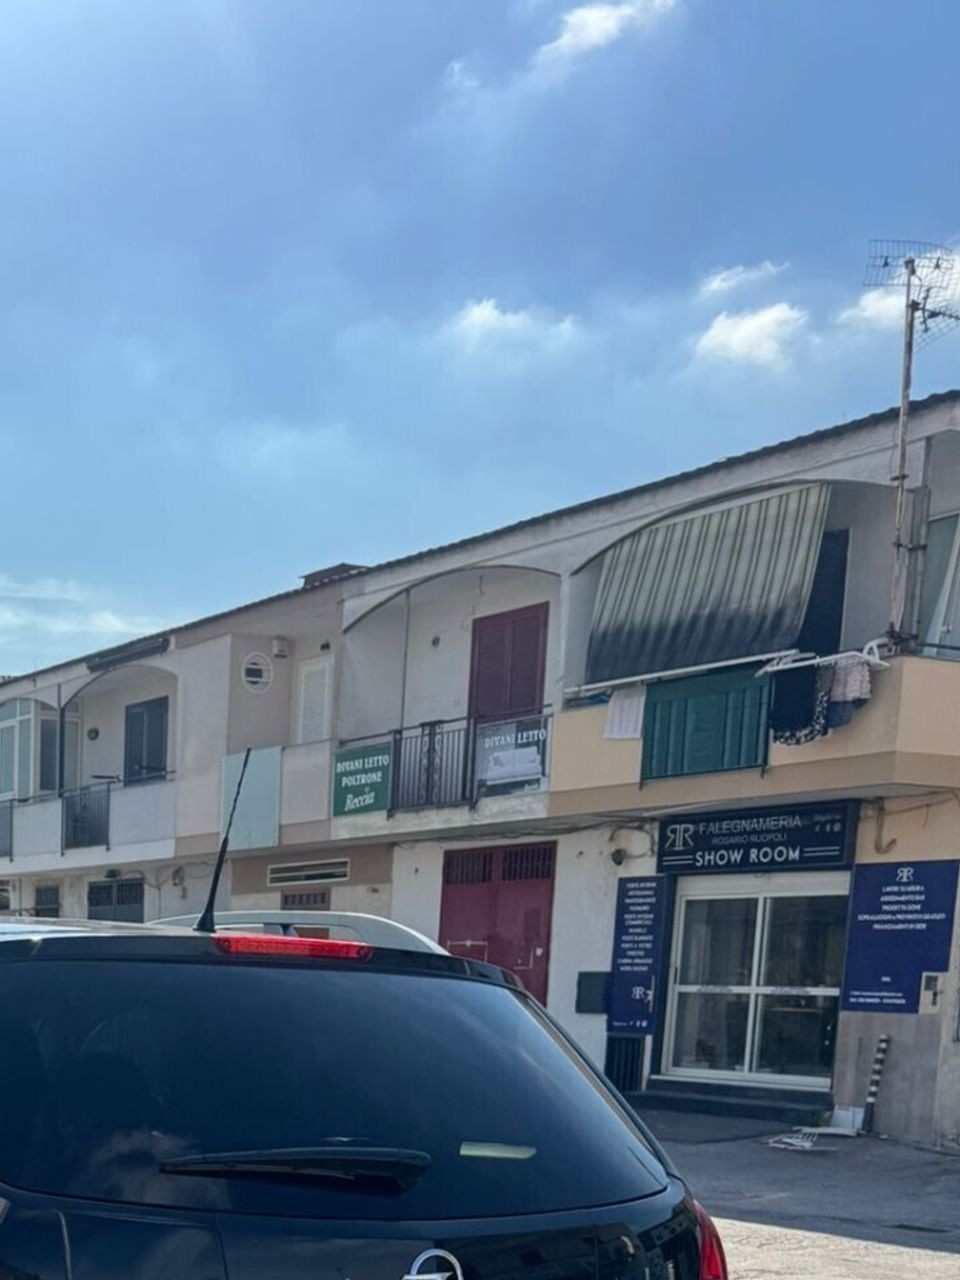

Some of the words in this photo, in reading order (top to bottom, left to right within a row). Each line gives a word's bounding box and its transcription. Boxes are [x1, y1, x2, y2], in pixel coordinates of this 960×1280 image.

[484, 732, 515, 748] DIVANI
[517, 728, 546, 744] LETTO
[336, 759, 363, 773] DIVANI
[364, 754, 390, 768] LETTO
[342, 770, 382, 787] POLTRONE
[699, 815, 802, 835] FALEGNAMERIA
[712, 835, 748, 846] ROSARIO
[695, 848, 744, 867] SHOW
[749, 846, 800, 864] ROOM
